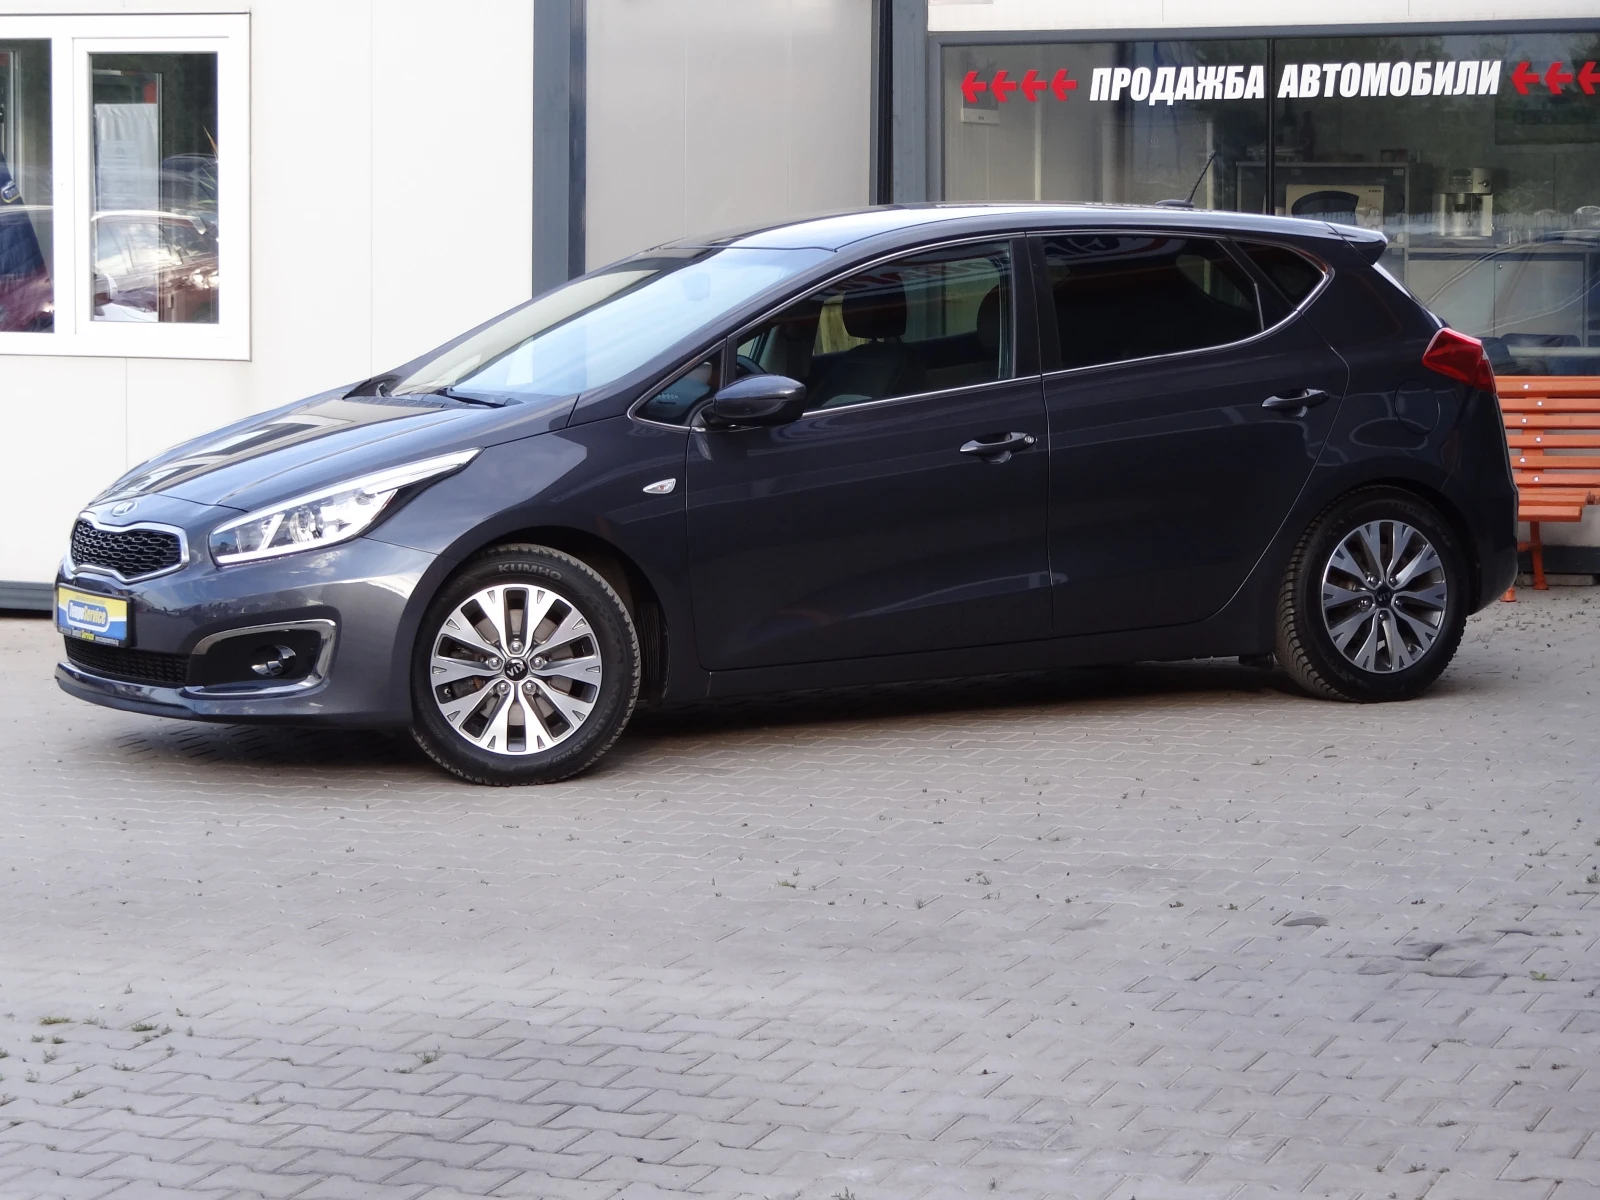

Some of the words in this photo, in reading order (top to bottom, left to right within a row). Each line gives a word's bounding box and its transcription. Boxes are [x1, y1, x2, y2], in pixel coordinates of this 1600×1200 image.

[1089, 65, 1265, 106] ПРОДАЖБА
[1276, 60, 1502, 98] АВТОМОБИЛИ
[498, 563, 562, 580] KUMHO
[507, 663, 526, 677] KIA
